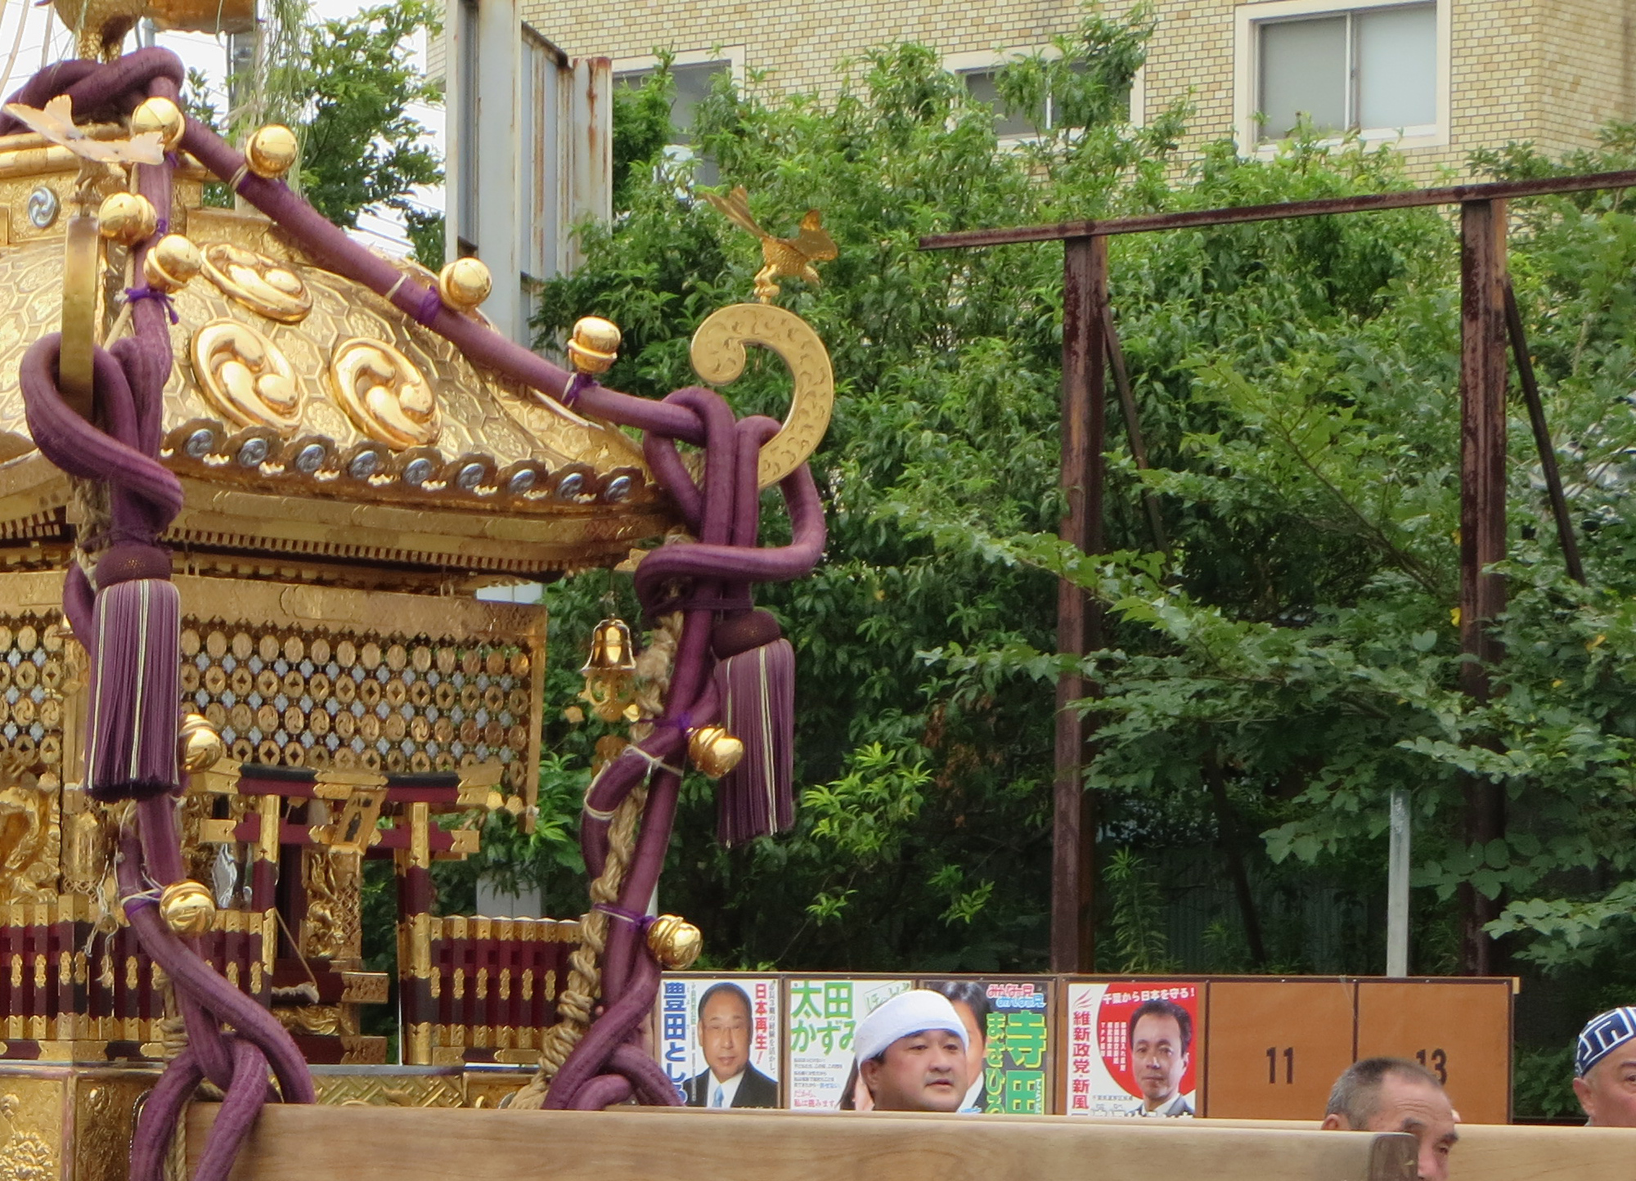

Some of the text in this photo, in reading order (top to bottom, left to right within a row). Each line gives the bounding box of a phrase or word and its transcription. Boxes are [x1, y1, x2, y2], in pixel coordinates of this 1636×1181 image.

[791, 980, 854, 1019] 太田
[755, 984, 768, 1064] 日本再生！
[791, 1020, 857, 1055] かずみ
[985, 1012, 1006, 1114] まさひろ
[1005, 1010, 1047, 1114] 寺田
[1266, 1047, 1294, 1084] 11
[1416, 1049, 1447, 1085] 13
